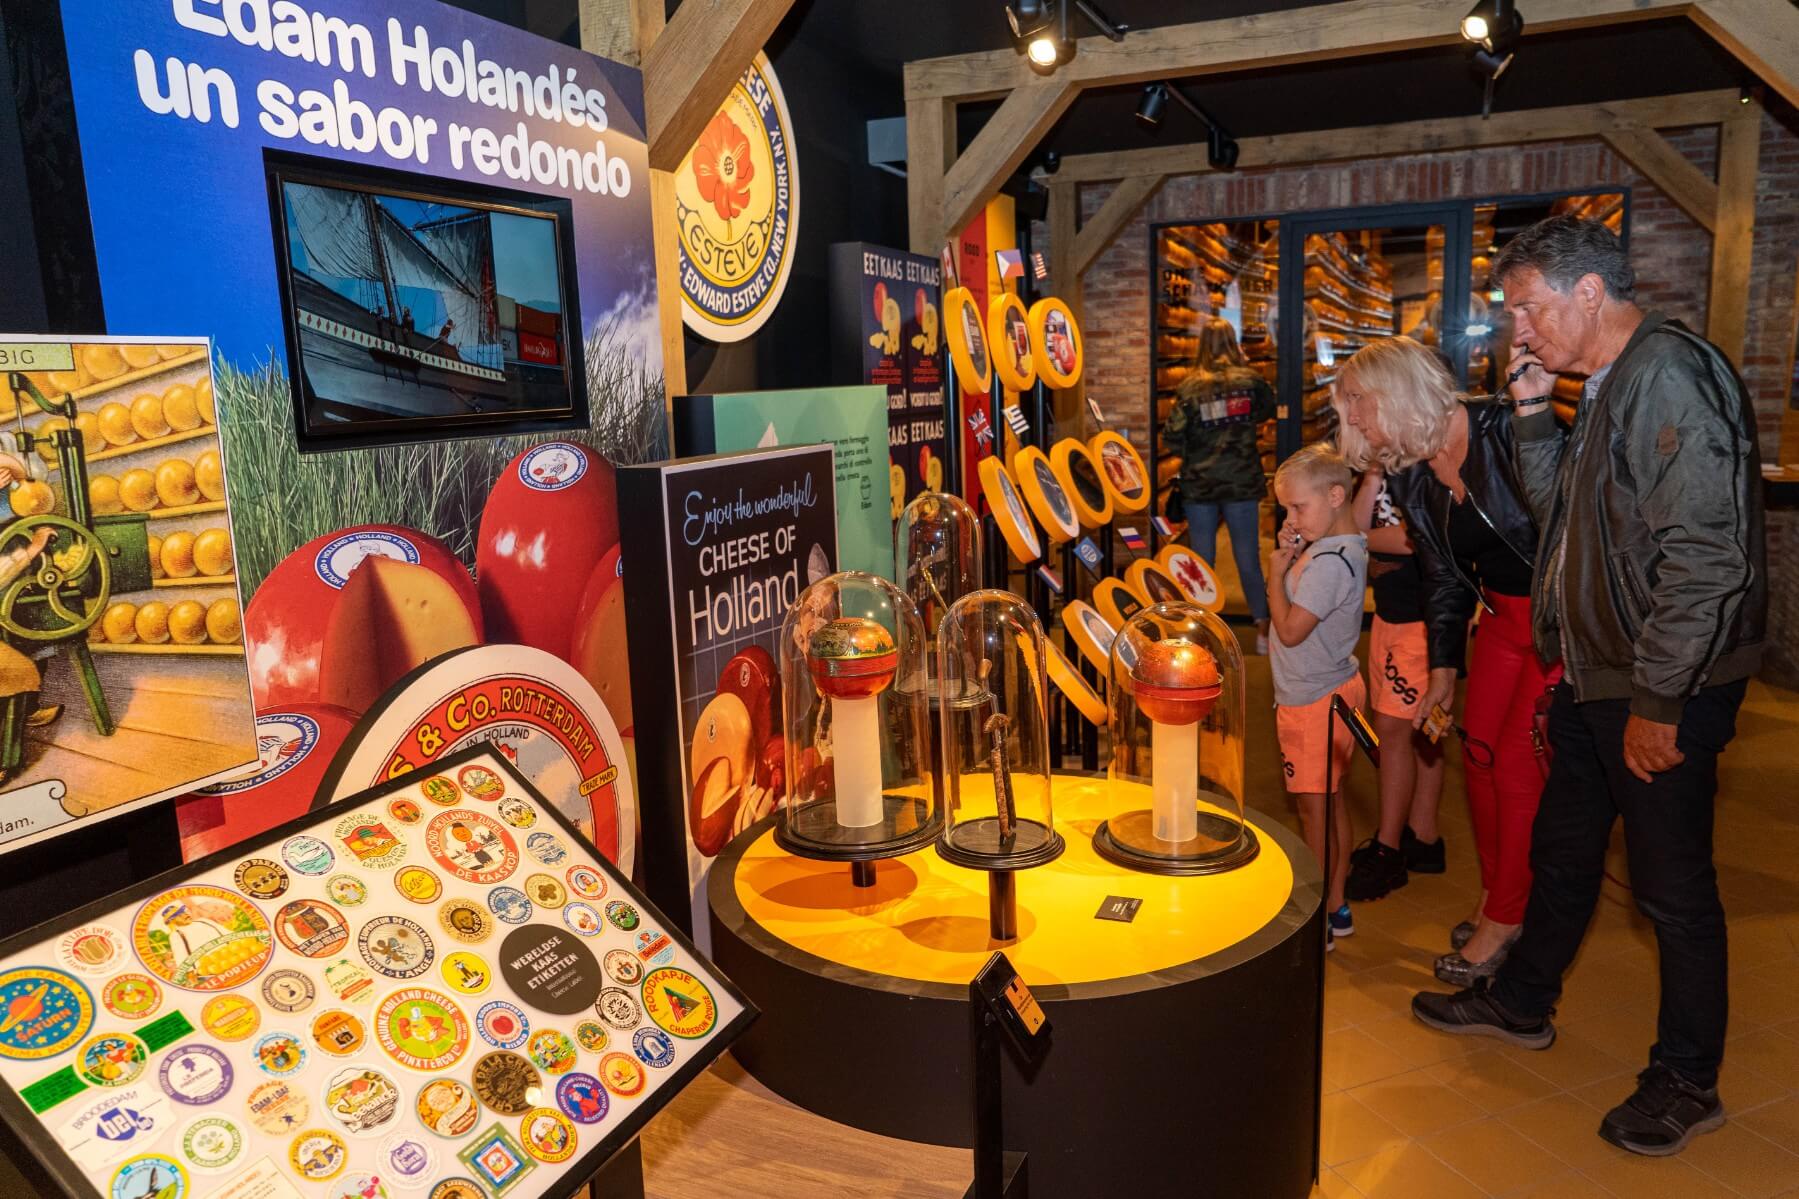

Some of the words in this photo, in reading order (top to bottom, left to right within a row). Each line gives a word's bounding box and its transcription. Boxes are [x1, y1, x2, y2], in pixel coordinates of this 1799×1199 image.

[387, 17, 609, 132] Holandés
[134, 49, 240, 129] un
[256, 79, 438, 165] sabor
[448, 121, 632, 198] redondo
[690, 224, 759, 276] ESTEVE
[771, 215, 787, 258] NEW
[684, 266, 732, 314] EDWARD
[732, 273, 767, 313] ESTEVE
[683, 490, 734, 546] Enjoy
[733, 488, 754, 520] the
[754, 472, 817, 518] wonderful
[323, 539, 349, 559] HOLLAND
[396, 539, 416, 560] HOLLAND
[699, 530, 771, 578] CHEESE
[775, 525, 797, 555] OF
[320, 563, 342, 585] HOLLAND
[688, 558, 800, 648] Holland
[417, 723, 447, 759] &
[500, 686, 595, 762] ROTTERDAM
[465, 734, 479, 750] IN
[483, 727, 531, 741] HOLLAND
[264, 750, 306, 778] HOLLAND
[599, 770, 616, 785] MARK
[335, 813, 365, 838] FROMAGE
[478, 814, 505, 834] ZUIVEL
[456, 868, 473, 880] DE
[477, 850, 518, 883] KAASKOP
[391, 917, 405, 925] DE
[404, 920, 434, 951] HOLLANDE
[509, 935, 563, 972] WERELDSE
[531, 951, 560, 974] KAAS
[526, 952, 580, 991] ETIKETTEN
[383, 990, 423, 1013] HOLLAND
[423, 991, 458, 1016] CHEESE
[644, 970, 693, 1014] ROODKAPJE
[16, 1008, 73, 1042] SATURN
[377, 1012, 397, 1051] GENUINE
[669, 1021, 710, 1036] CHAPERON
[704, 994, 713, 1022] ROUGE
